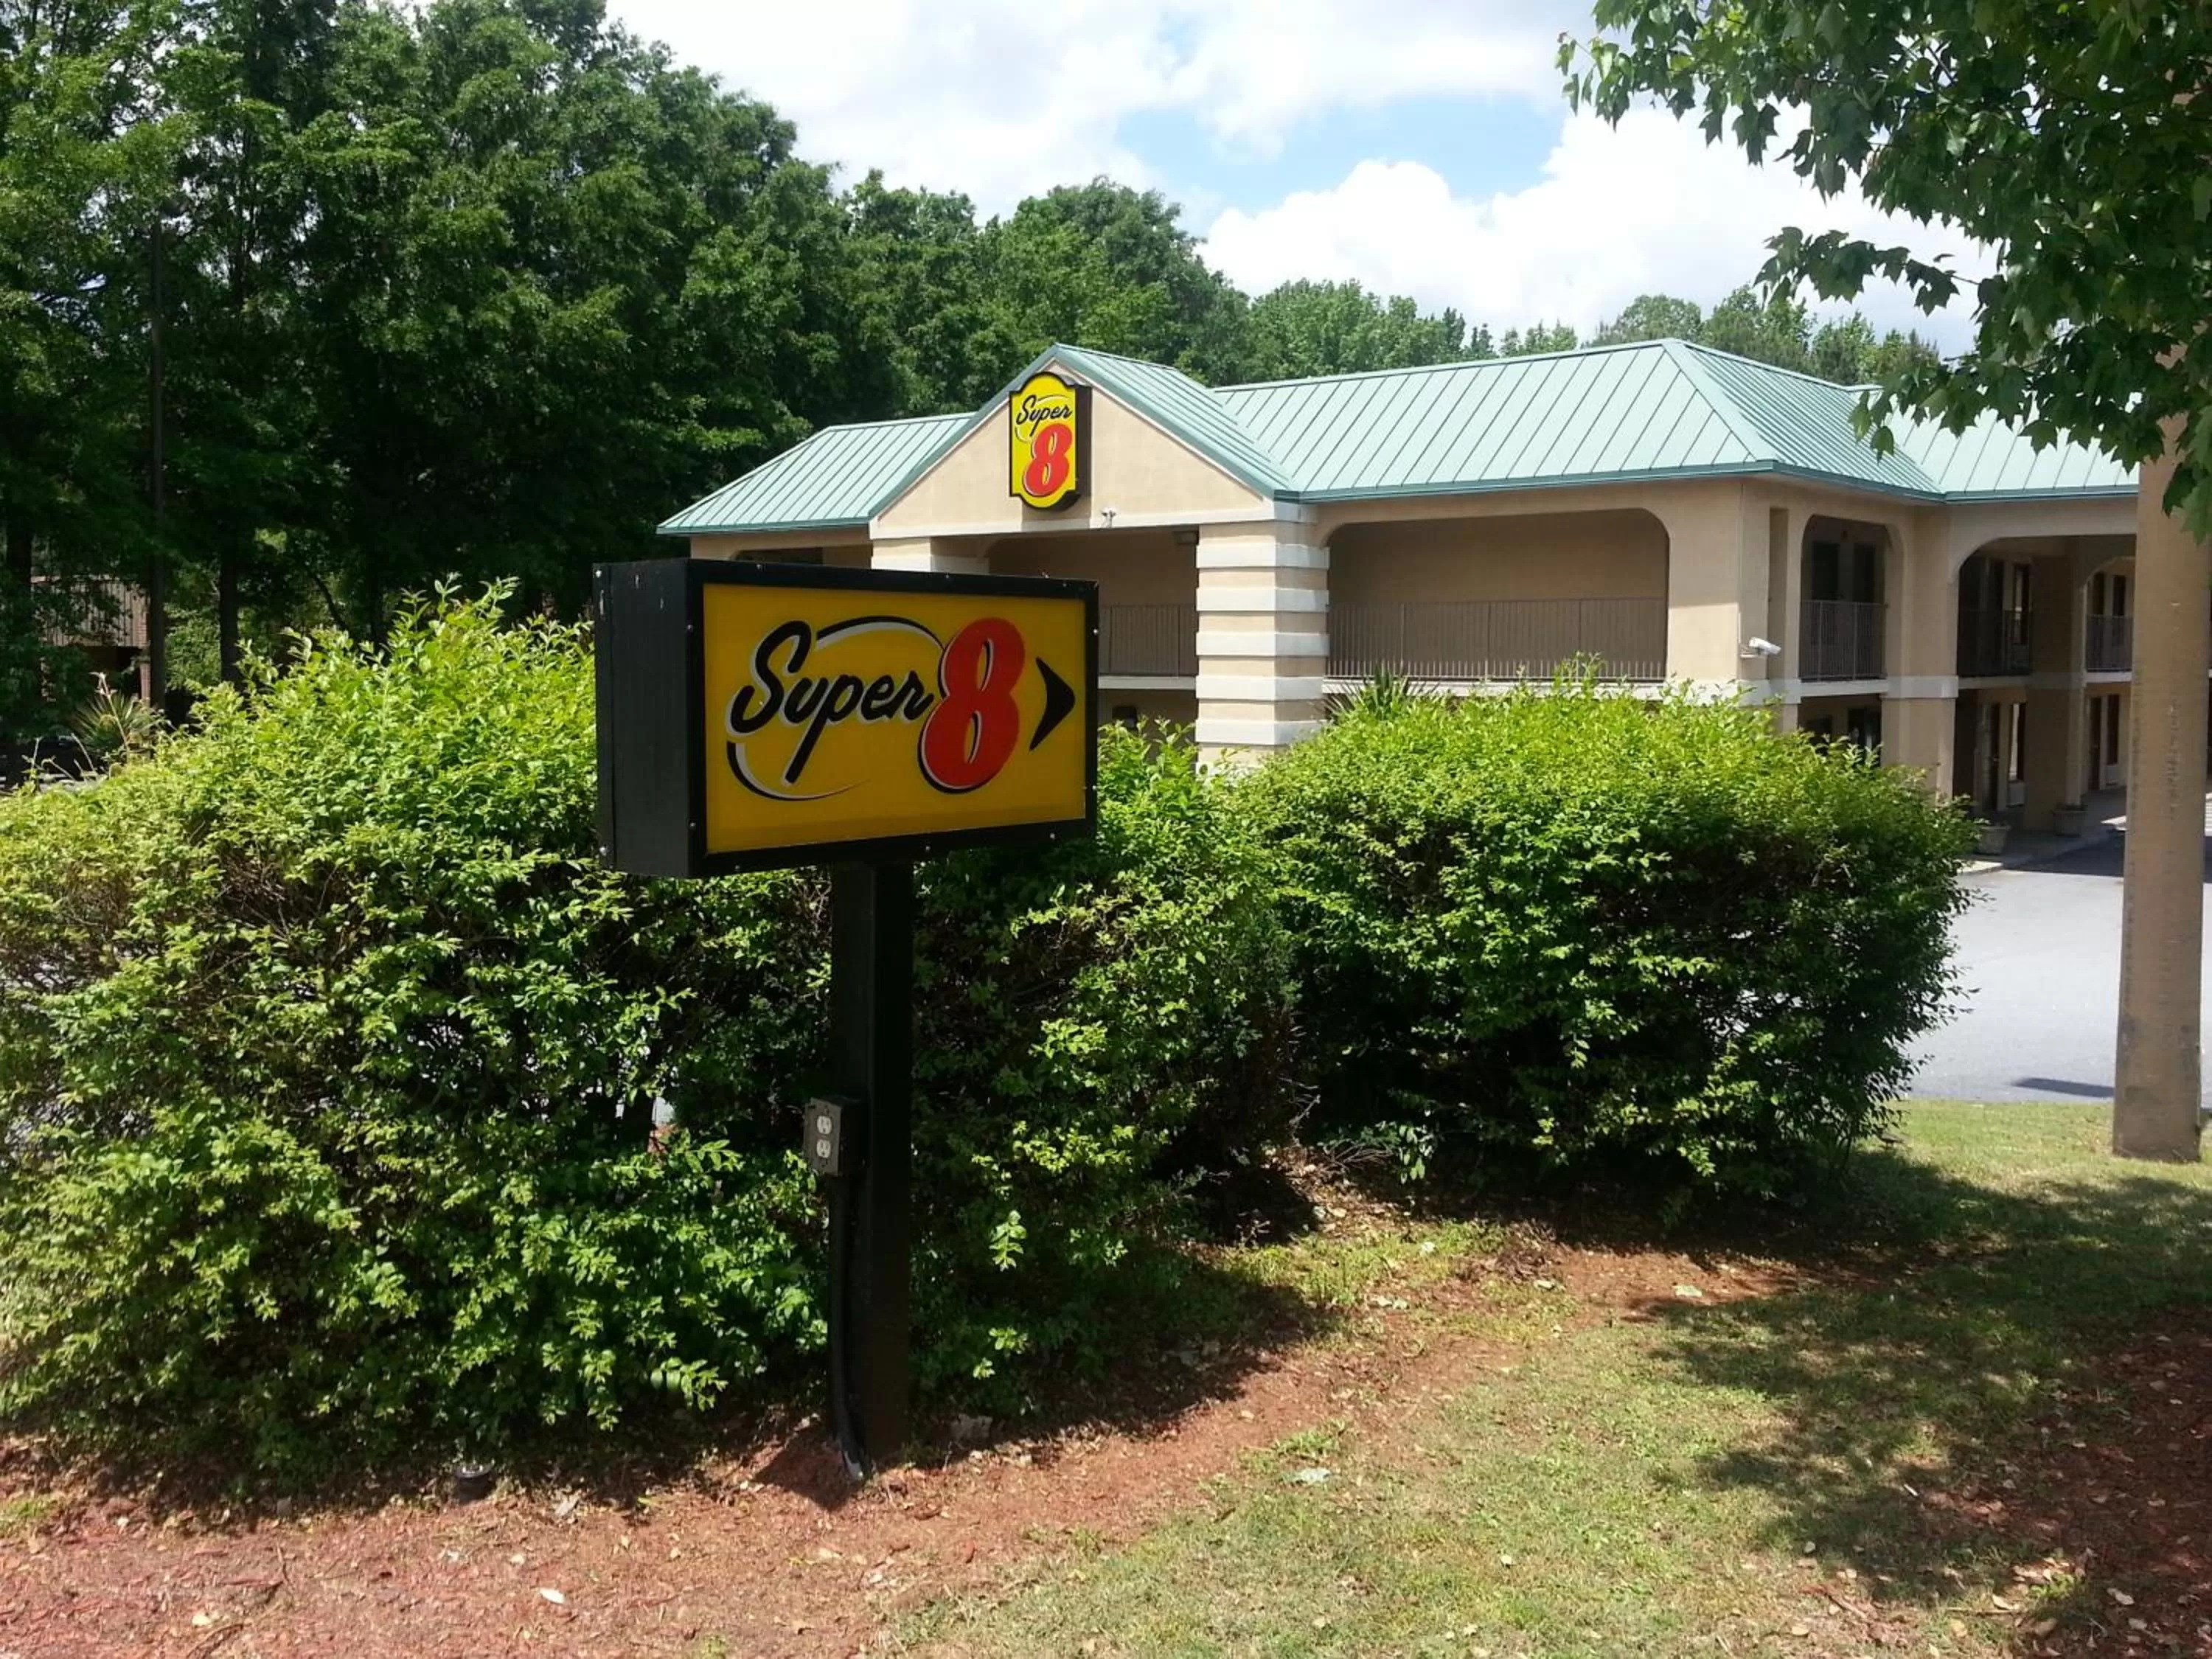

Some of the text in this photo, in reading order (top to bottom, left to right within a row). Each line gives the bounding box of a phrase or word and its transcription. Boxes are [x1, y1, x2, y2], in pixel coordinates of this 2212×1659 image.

[1015, 394, 1072, 437] Super
[1023, 423, 1073, 497] 8
[728, 617, 1026, 794] Super 8
